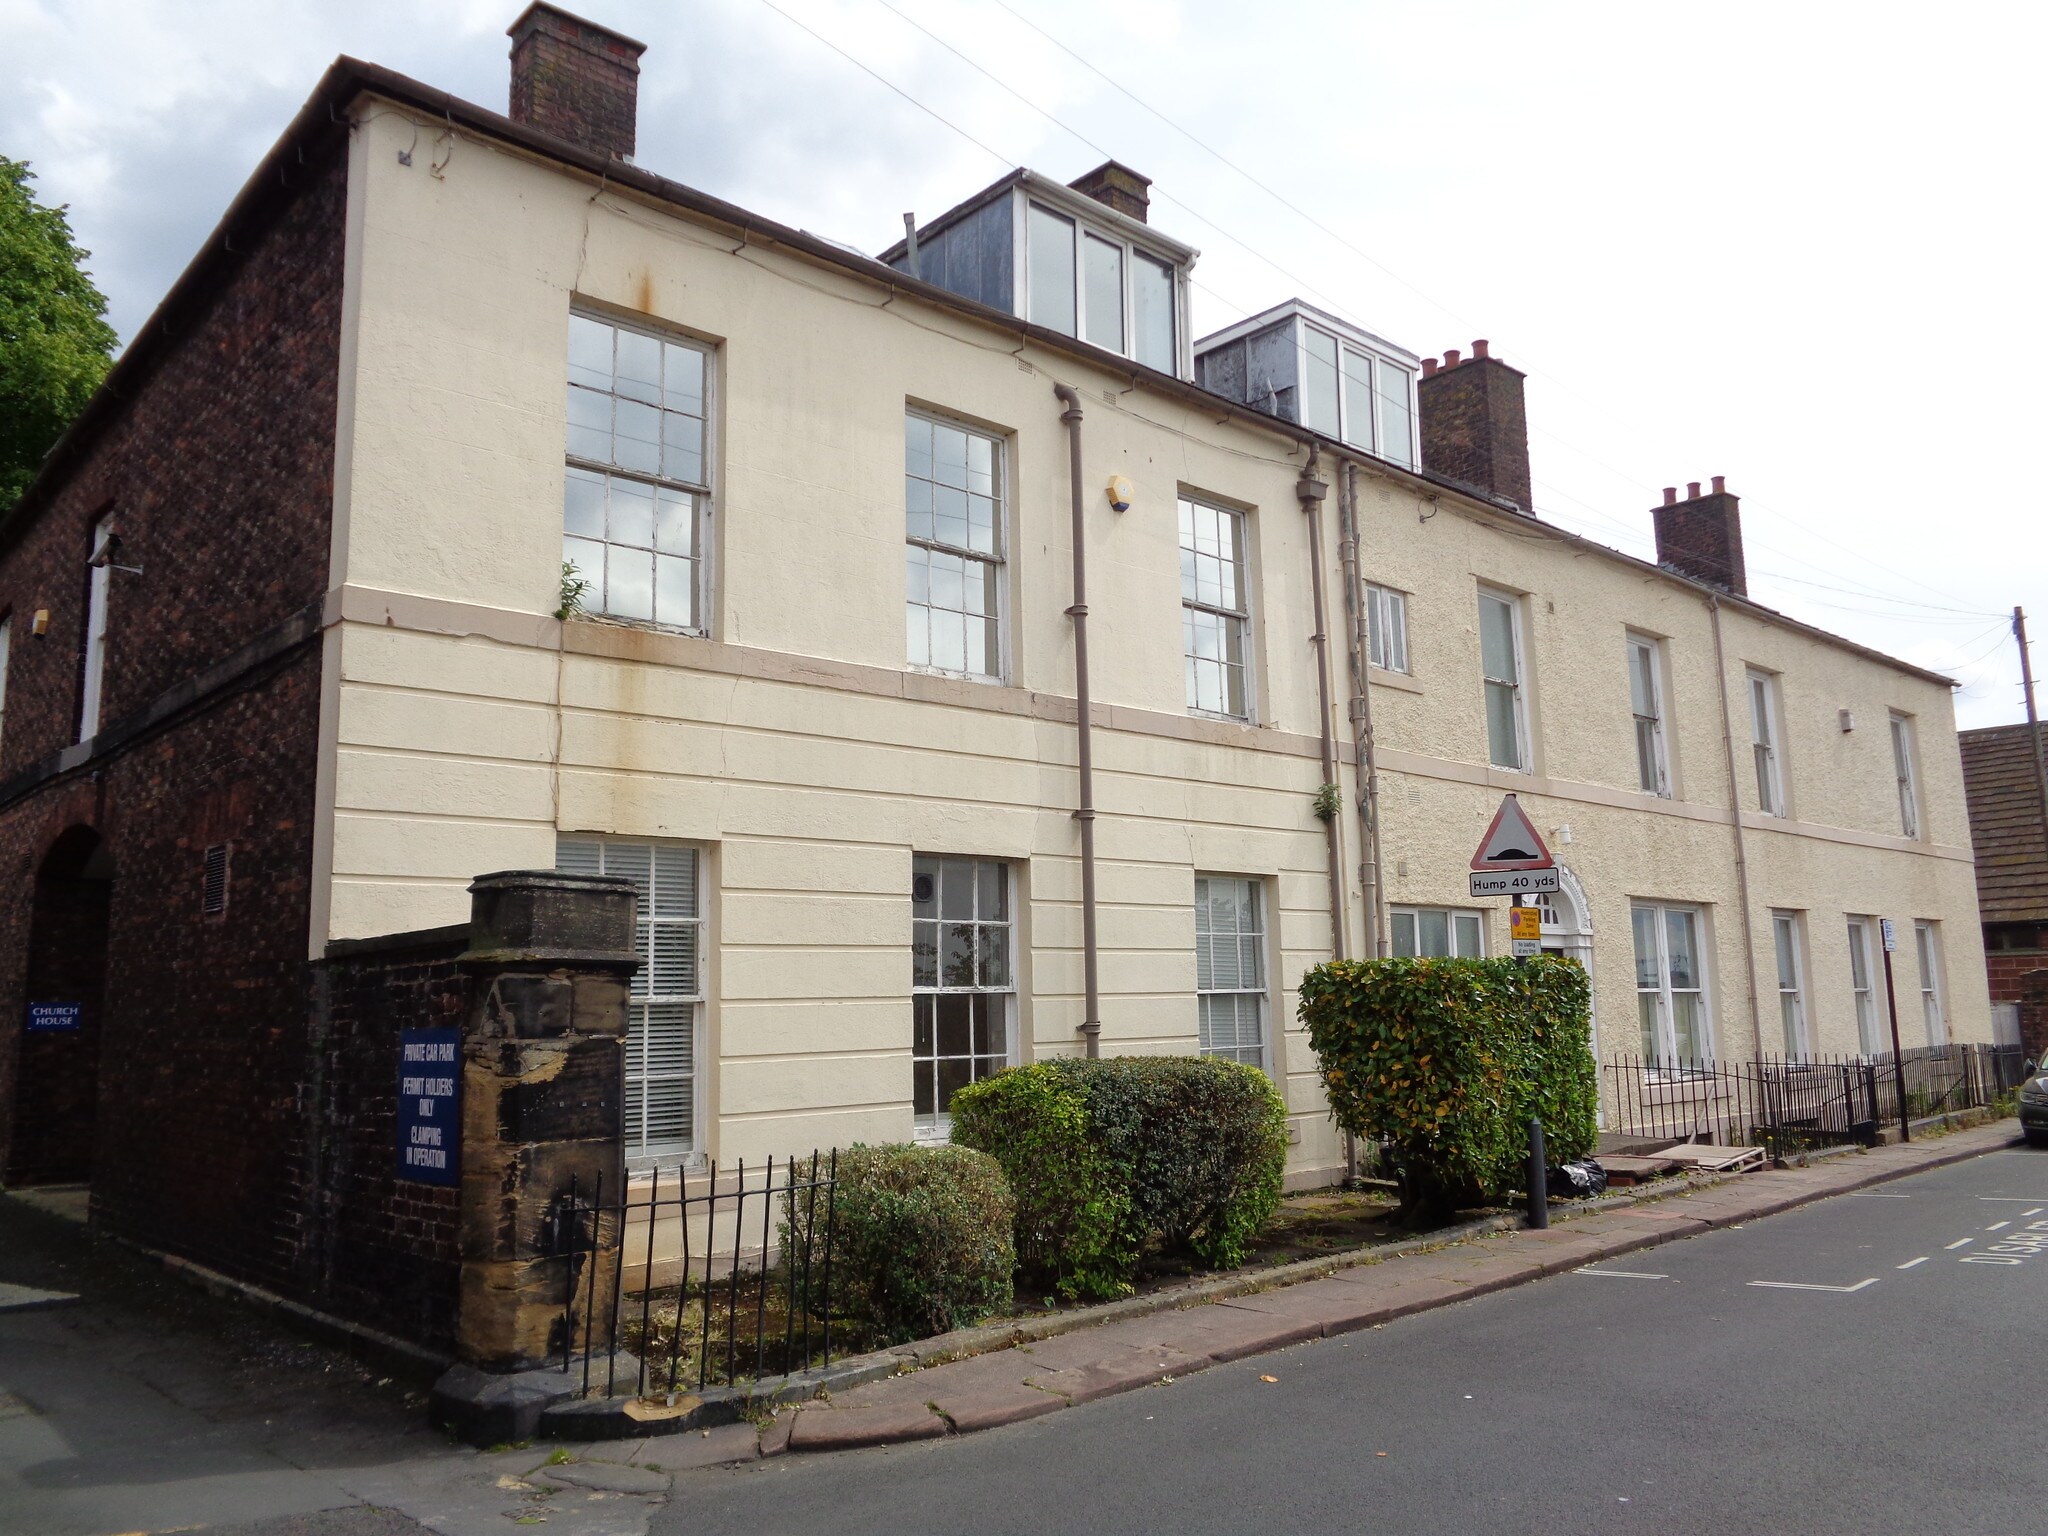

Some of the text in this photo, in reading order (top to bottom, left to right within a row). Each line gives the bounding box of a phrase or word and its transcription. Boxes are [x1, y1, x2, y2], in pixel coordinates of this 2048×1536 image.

[1473, 876, 1555, 890] Hump 40 yds
[32, 1007, 78, 1016] CHURCH
[36, 1017, 72, 1025] HOUSE
[404, 1043, 455, 1061] PRIVATE CAR PARK
[403, 1077, 453, 1096] PERMIT HOLDERS
[419, 1098, 434, 1116] ONLY
[411, 1125, 441, 1146] CLAMPING
[406, 1147, 446, 1169] IN OPERATION
